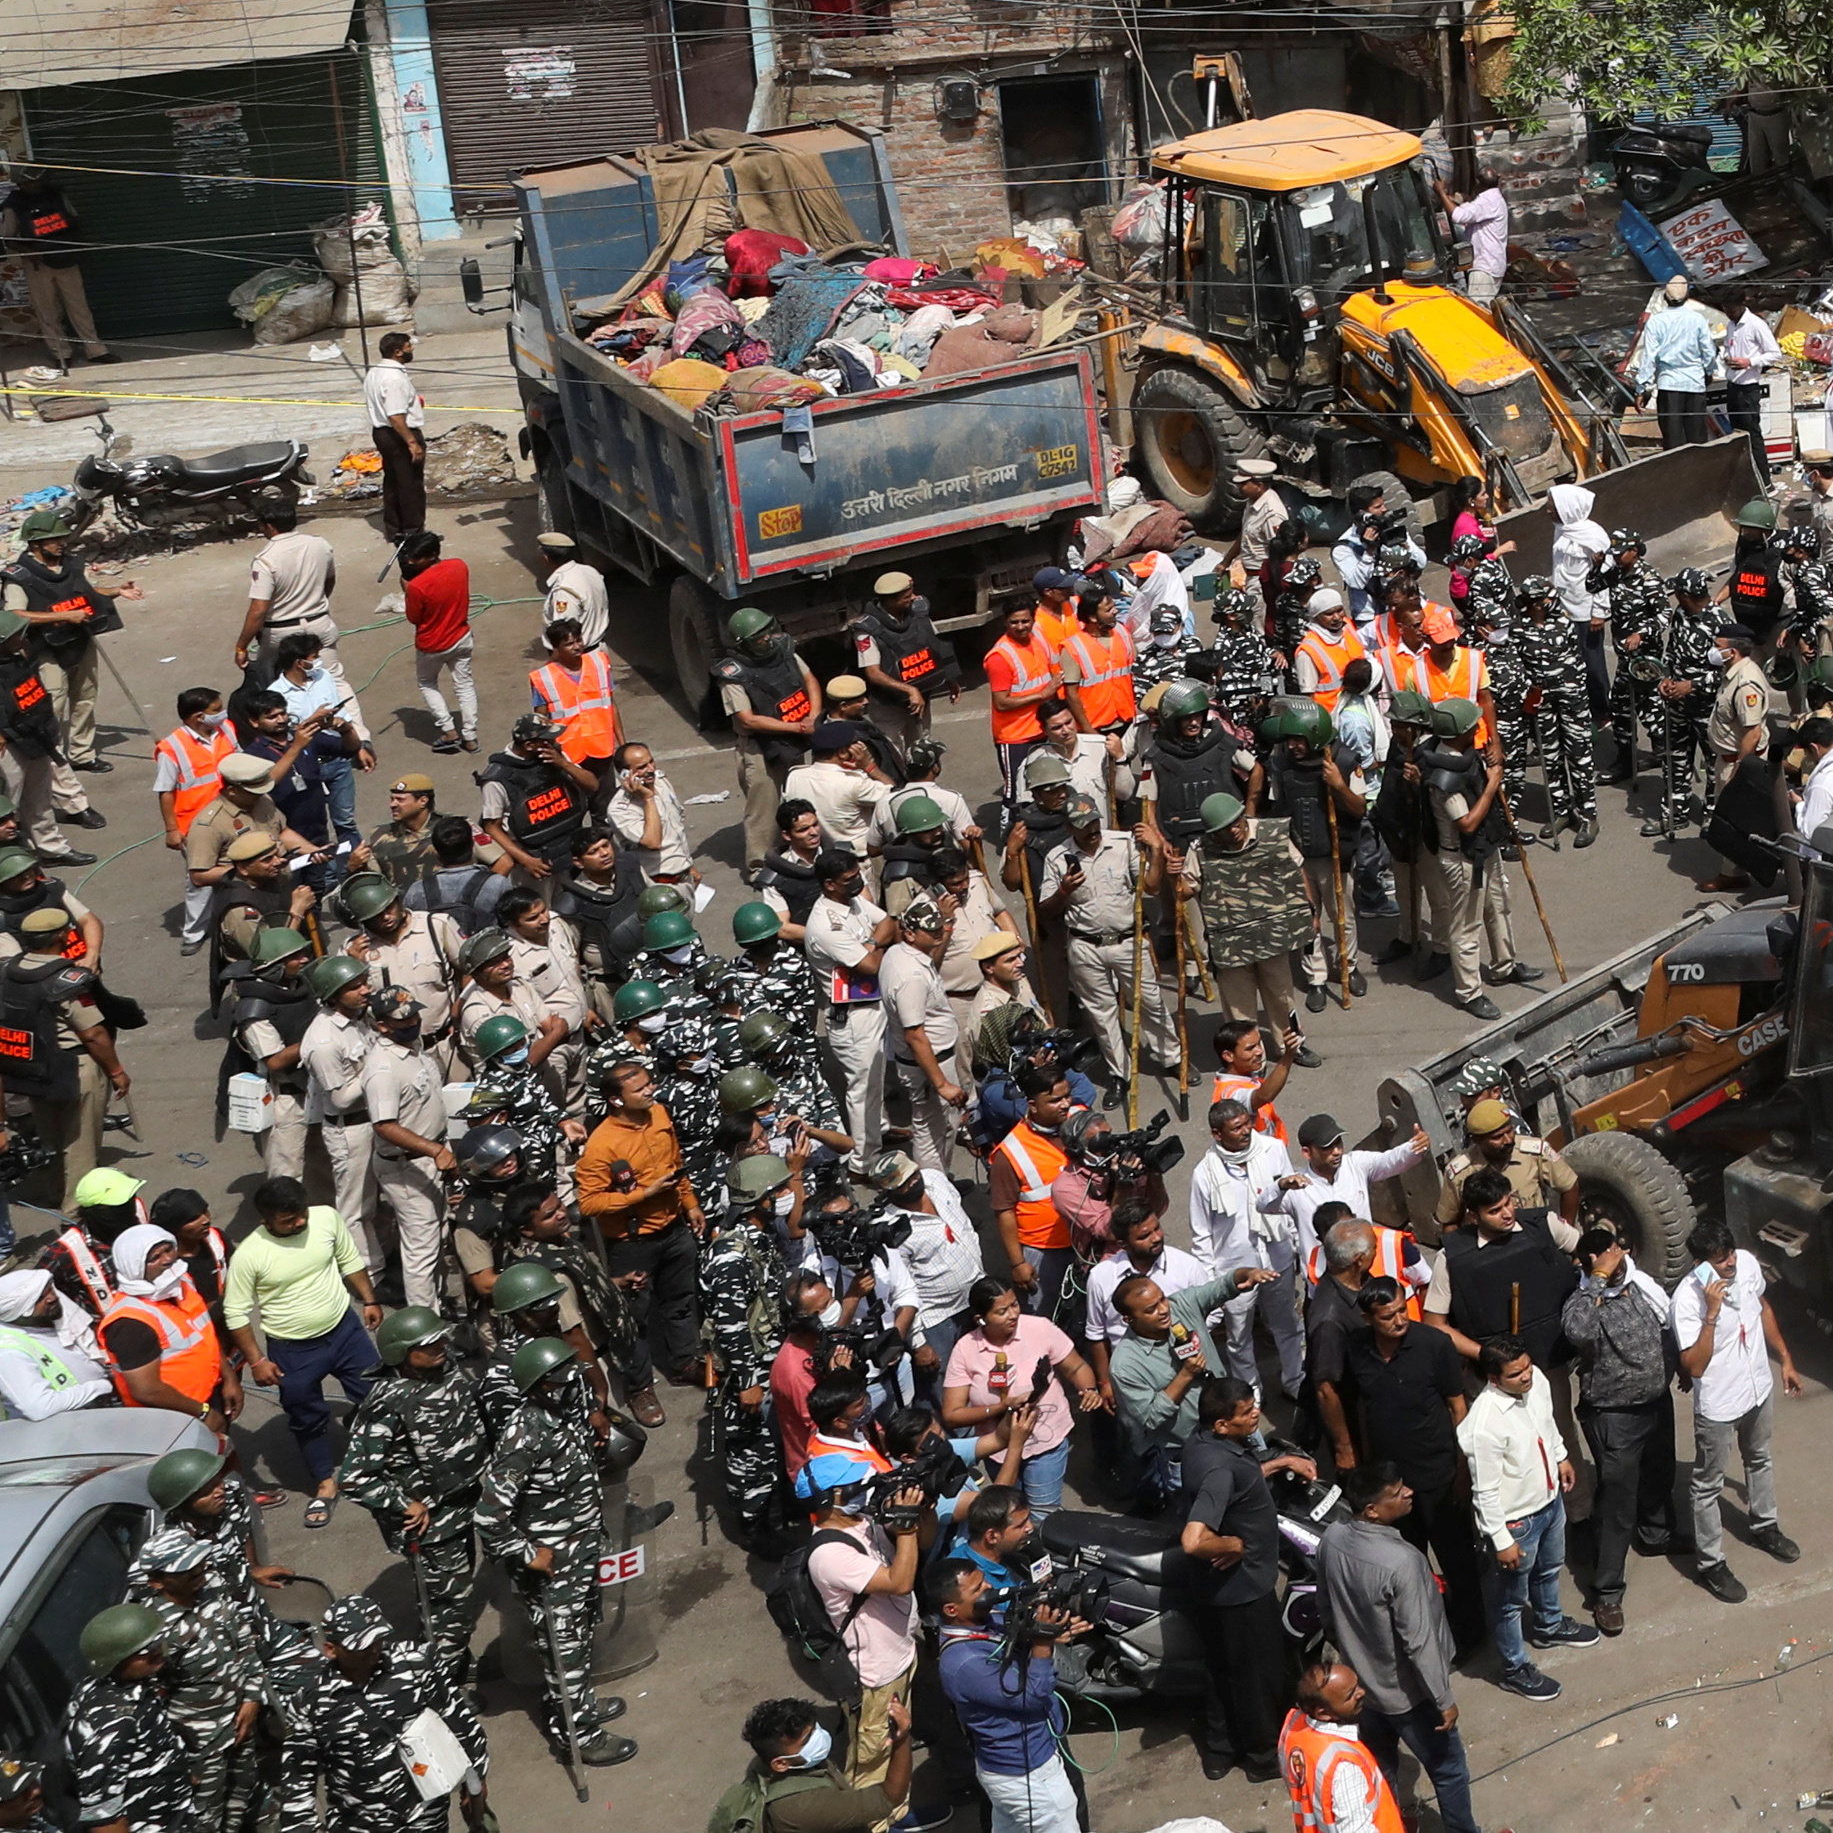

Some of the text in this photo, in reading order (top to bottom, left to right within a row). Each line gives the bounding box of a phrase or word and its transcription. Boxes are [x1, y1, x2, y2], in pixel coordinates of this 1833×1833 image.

[34, 221, 68, 236] POLICE
[1667, 207, 1713, 237] एक
[840, 464, 1018, 520] उत्तरी दिल्ली नगर निगम
[1740, 572, 1765, 585] DELHI
[1737, 584, 1767, 597] POLICE
[52, 596, 87, 613] DELHI
[902, 649, 930, 669] DELHI
[902, 659, 935, 681] POLICE
[15, 678, 39, 698] DELHI
[18, 687, 45, 709] POLICE
[779, 690, 806, 713] DELHI
[782, 700, 811, 723] POLICE
[527, 787, 562, 811] DELHI
[529, 798, 570, 825] POLICE
[61, 941, 87, 959] LICE
[1667, 963, 1705, 982] 770
[0, 1027, 28, 1043] ELHI
[1737, 1014, 1791, 1056] CASE
[0, 1042, 31, 1059] OLICE
